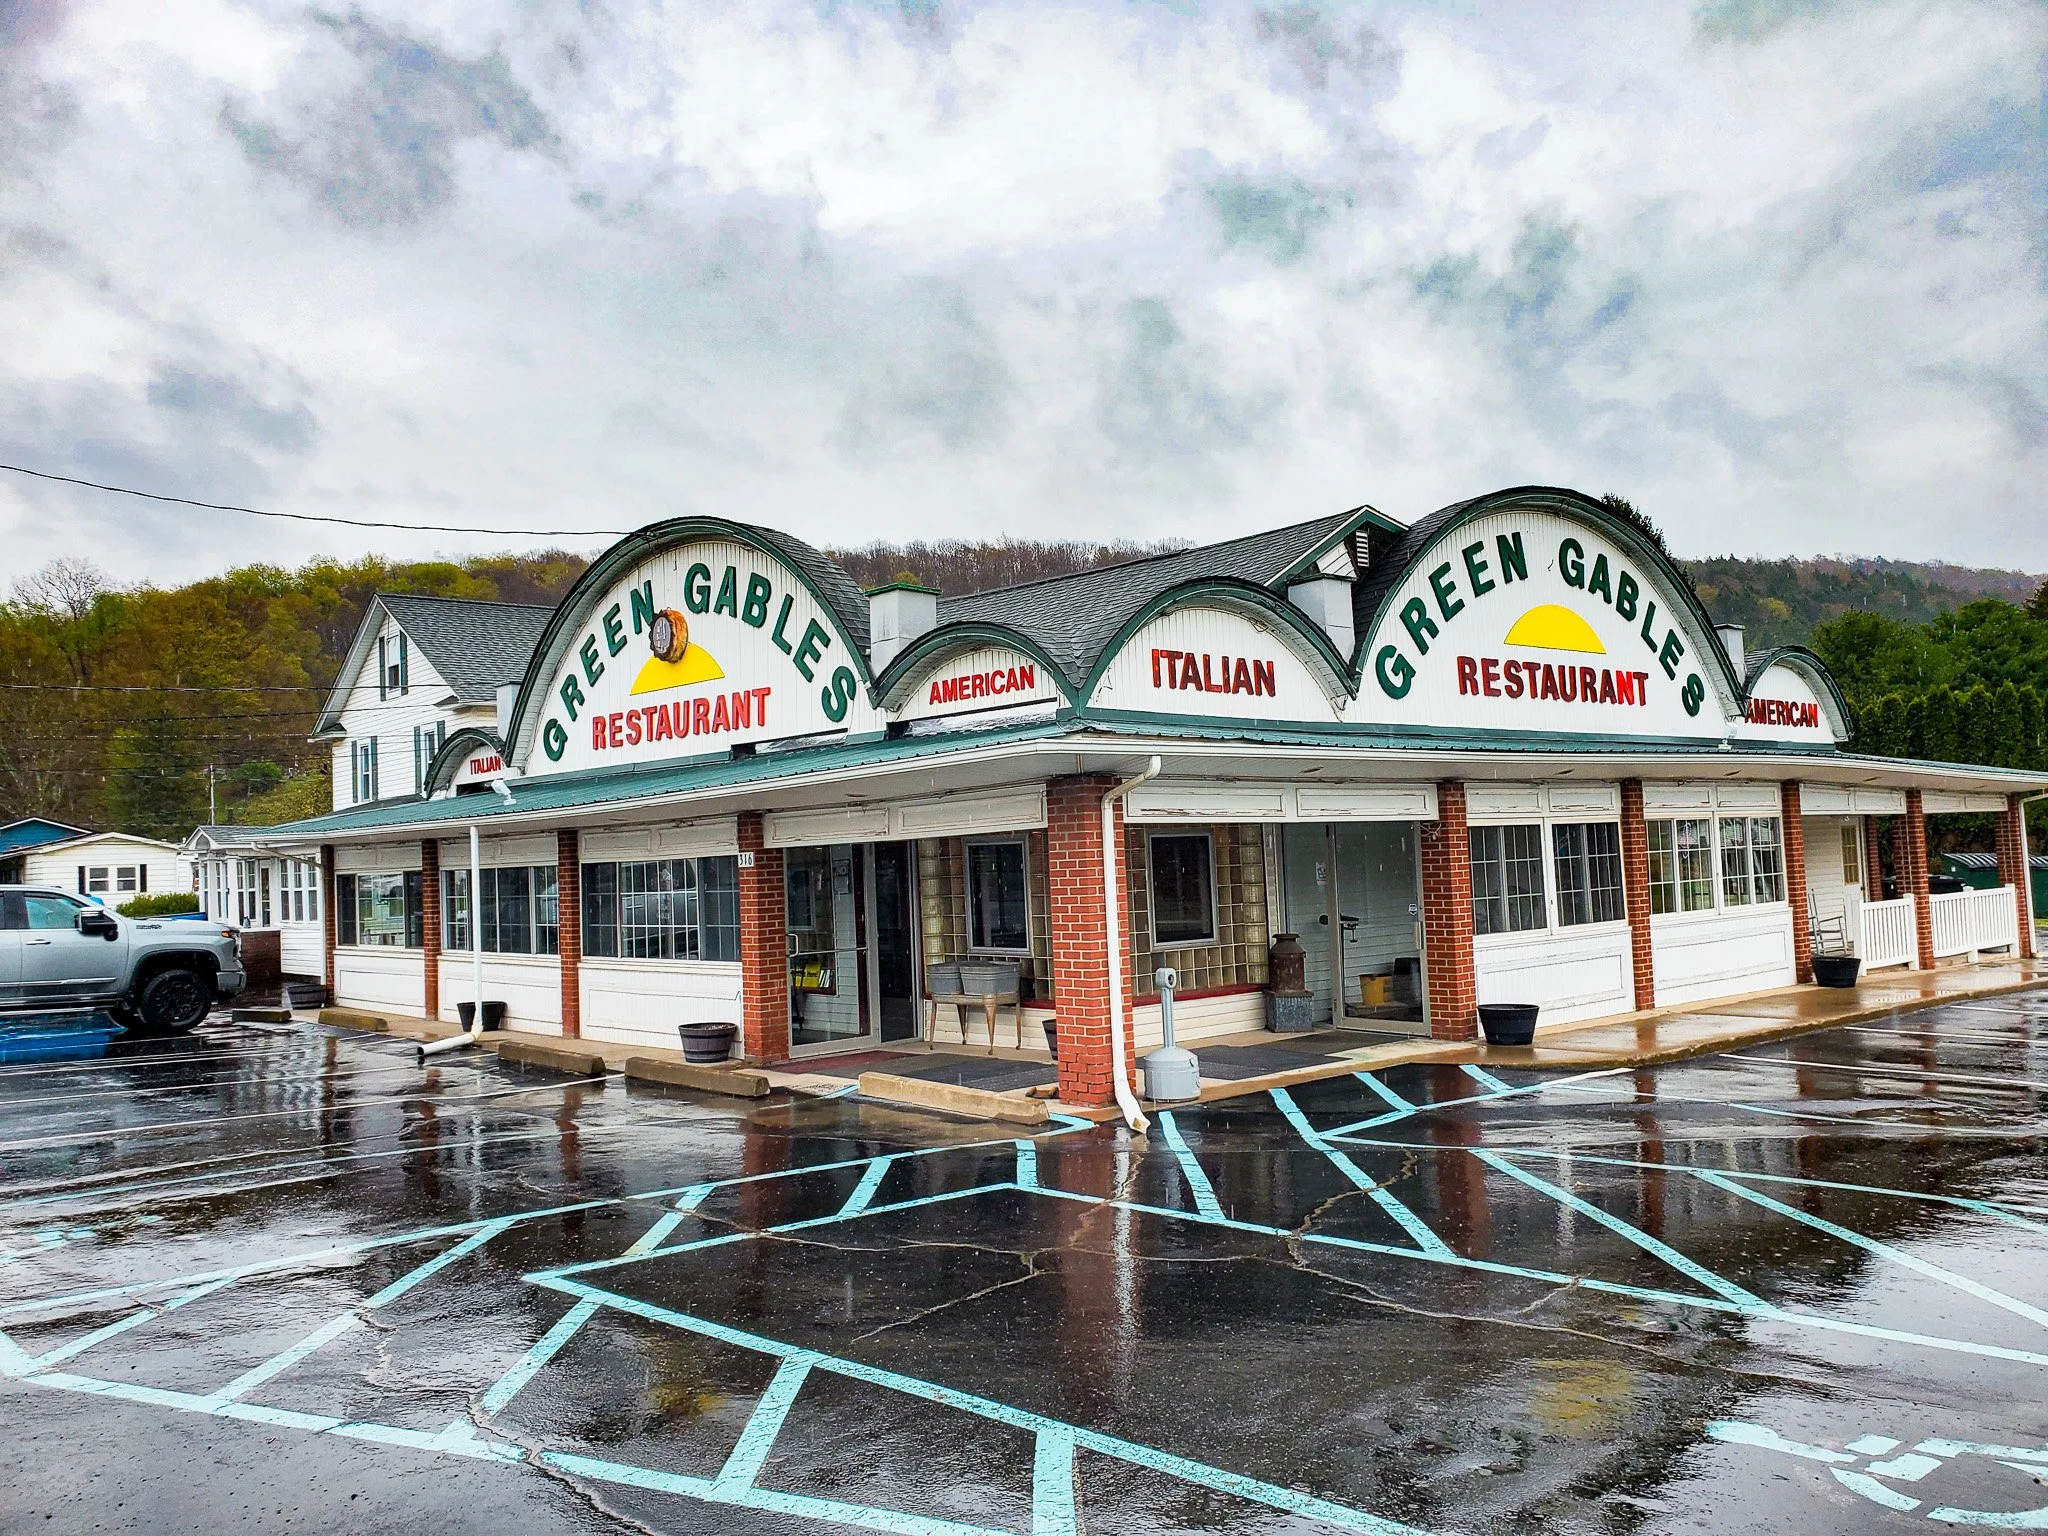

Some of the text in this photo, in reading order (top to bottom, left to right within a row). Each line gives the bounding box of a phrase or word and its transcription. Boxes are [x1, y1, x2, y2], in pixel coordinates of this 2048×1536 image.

[1375, 532, 1705, 718] GREEN GABLES
[542, 562, 857, 762] GREEN GABLES
[929, 664, 1034, 705] AMERICAN
[1152, 649, 1276, 697] ITALIAN
[1456, 655, 1650, 706] RESTAURANT
[591, 687, 772, 750] RESTAURANT
[1745, 698, 1819, 728] AMERICAN
[470, 755, 501, 775] ITALIAN
[739, 853, 753, 866] 316
